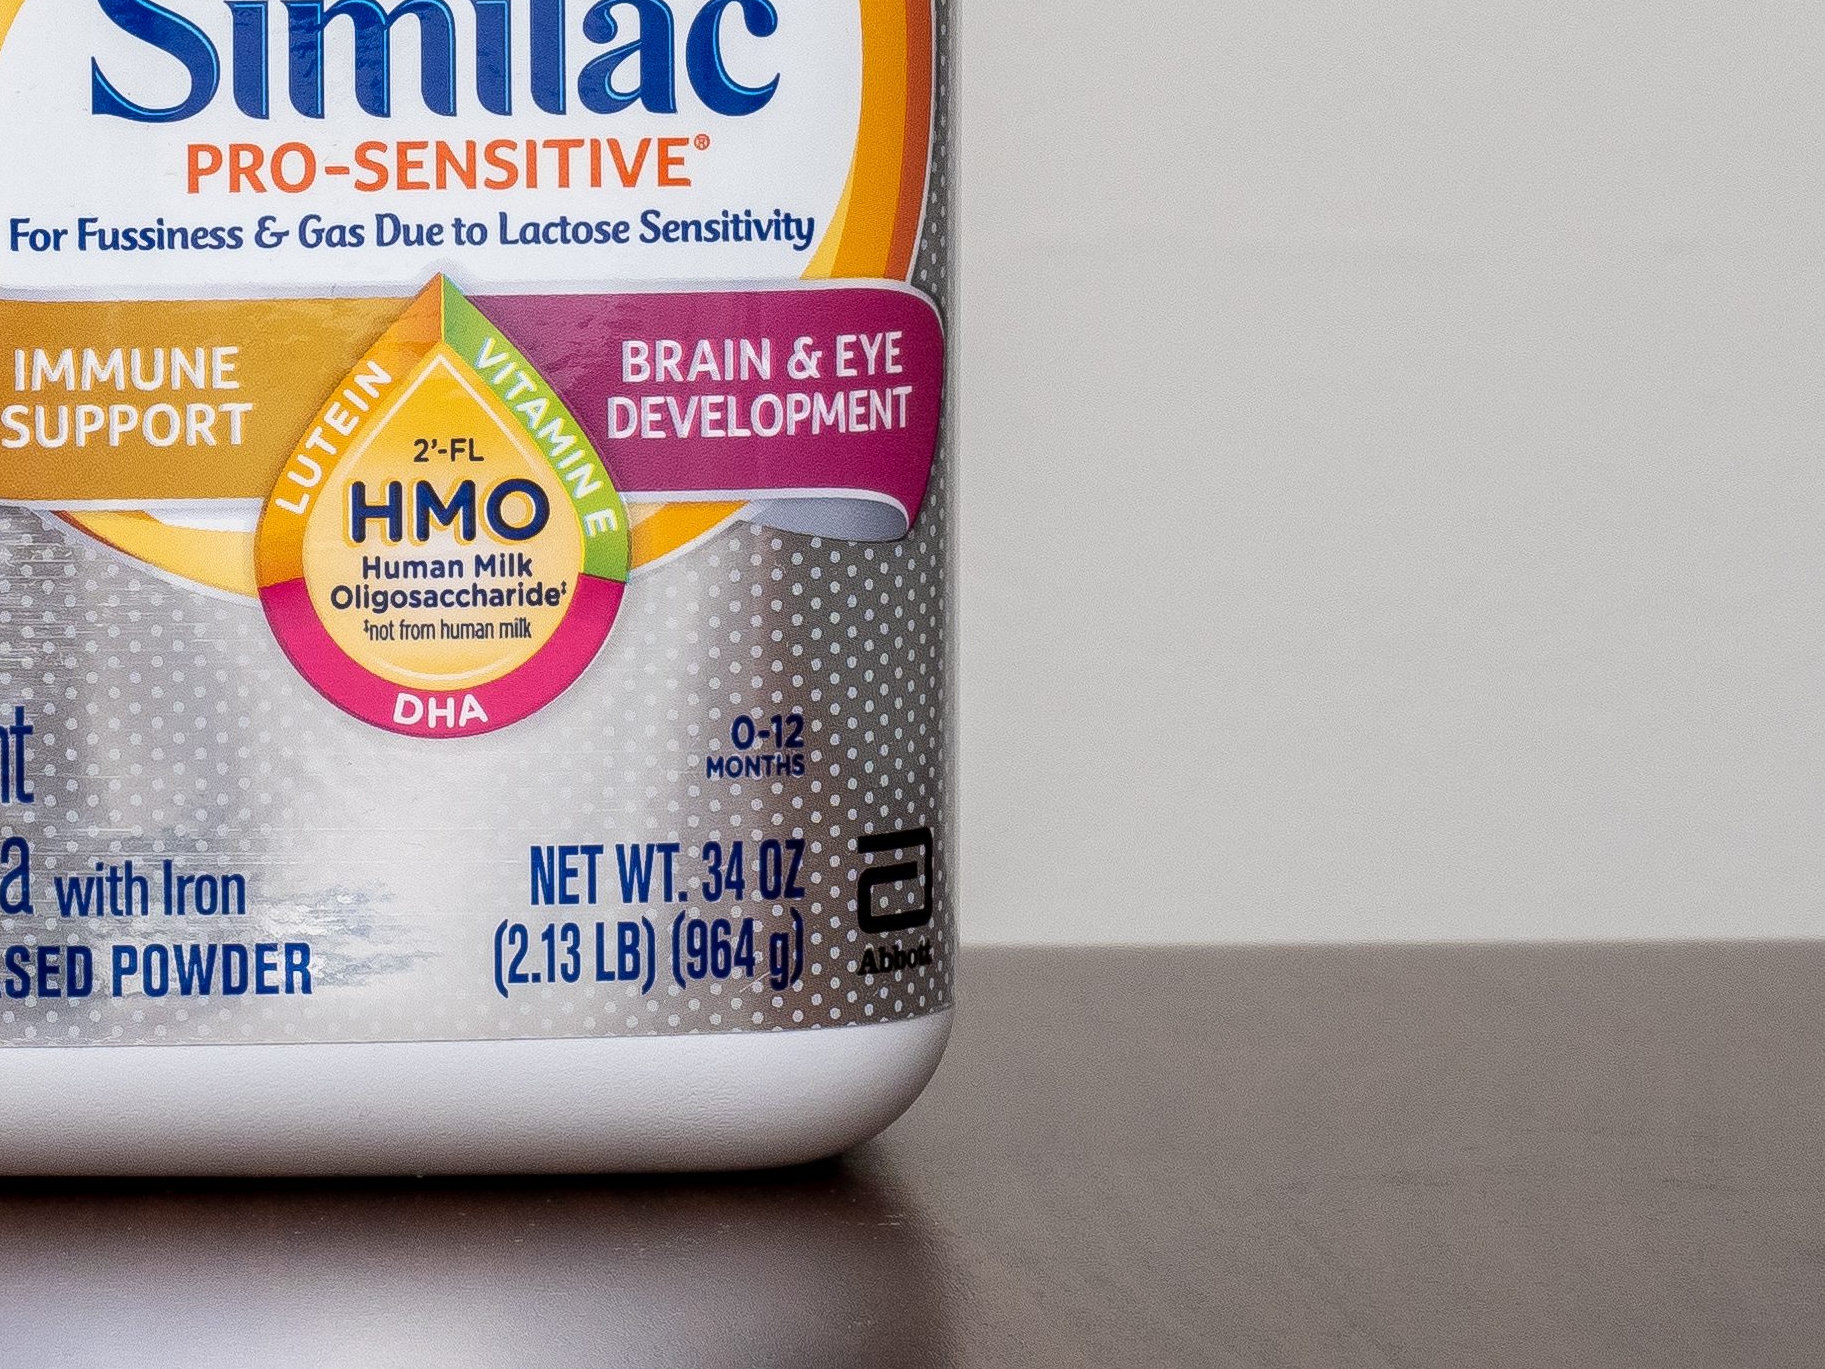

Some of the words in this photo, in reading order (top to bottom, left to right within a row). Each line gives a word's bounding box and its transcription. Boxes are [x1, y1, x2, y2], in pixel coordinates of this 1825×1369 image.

[186, 133, 711, 195] PRO-SENSITIVE®
[9, 218, 69, 252] For
[78, 217, 244, 252] Fussiness
[254, 216, 290, 249] &
[299, 214, 366, 249] Gas
[375, 213, 445, 247] Due
[452, 216, 489, 248] to
[499, 212, 630, 248] Lactose
[639, 210, 816, 251] Sensitivity
[14, 346, 241, 392] IMMUNE
[622, 338, 771, 383] BRAIN
[787, 335, 823, 381] &
[836, 331, 904, 378] EYE
[0, 402, 253, 449] SUPPORT
[275, 360, 392, 516] LUTEIN
[474, 337, 603, 499] VITAMIN
[583, 507, 617, 538] E
[607, 385, 913, 439] DEVELOPMENT
[349, 478, 551, 545] HMO
[363, 555, 464, 580] Human
[474, 553, 534, 579] Milk
[399, 618, 437, 641] from
[440, 617, 495, 640] human
[499, 617, 533, 639] milk
[392, 692, 490, 729] DHA
[731, 715, 805, 751] 0-12
[706, 753, 806, 779] MONTHS
[54, 861, 150, 918] with
[163, 859, 247, 916] Iron
[530, 844, 604, 906] NET
[615, 841, 689, 904] WT.
[702, 839, 746, 902] 34
[759, 837, 806, 900] OZ
[112, 942, 314, 997] POWDER
[494, 918, 582, 999] (2.13
[595, 915, 657, 996] LB)
[673, 910, 757, 991] (964
[769, 907, 805, 992] g)
[858, 939, 932, 976] Abbott
